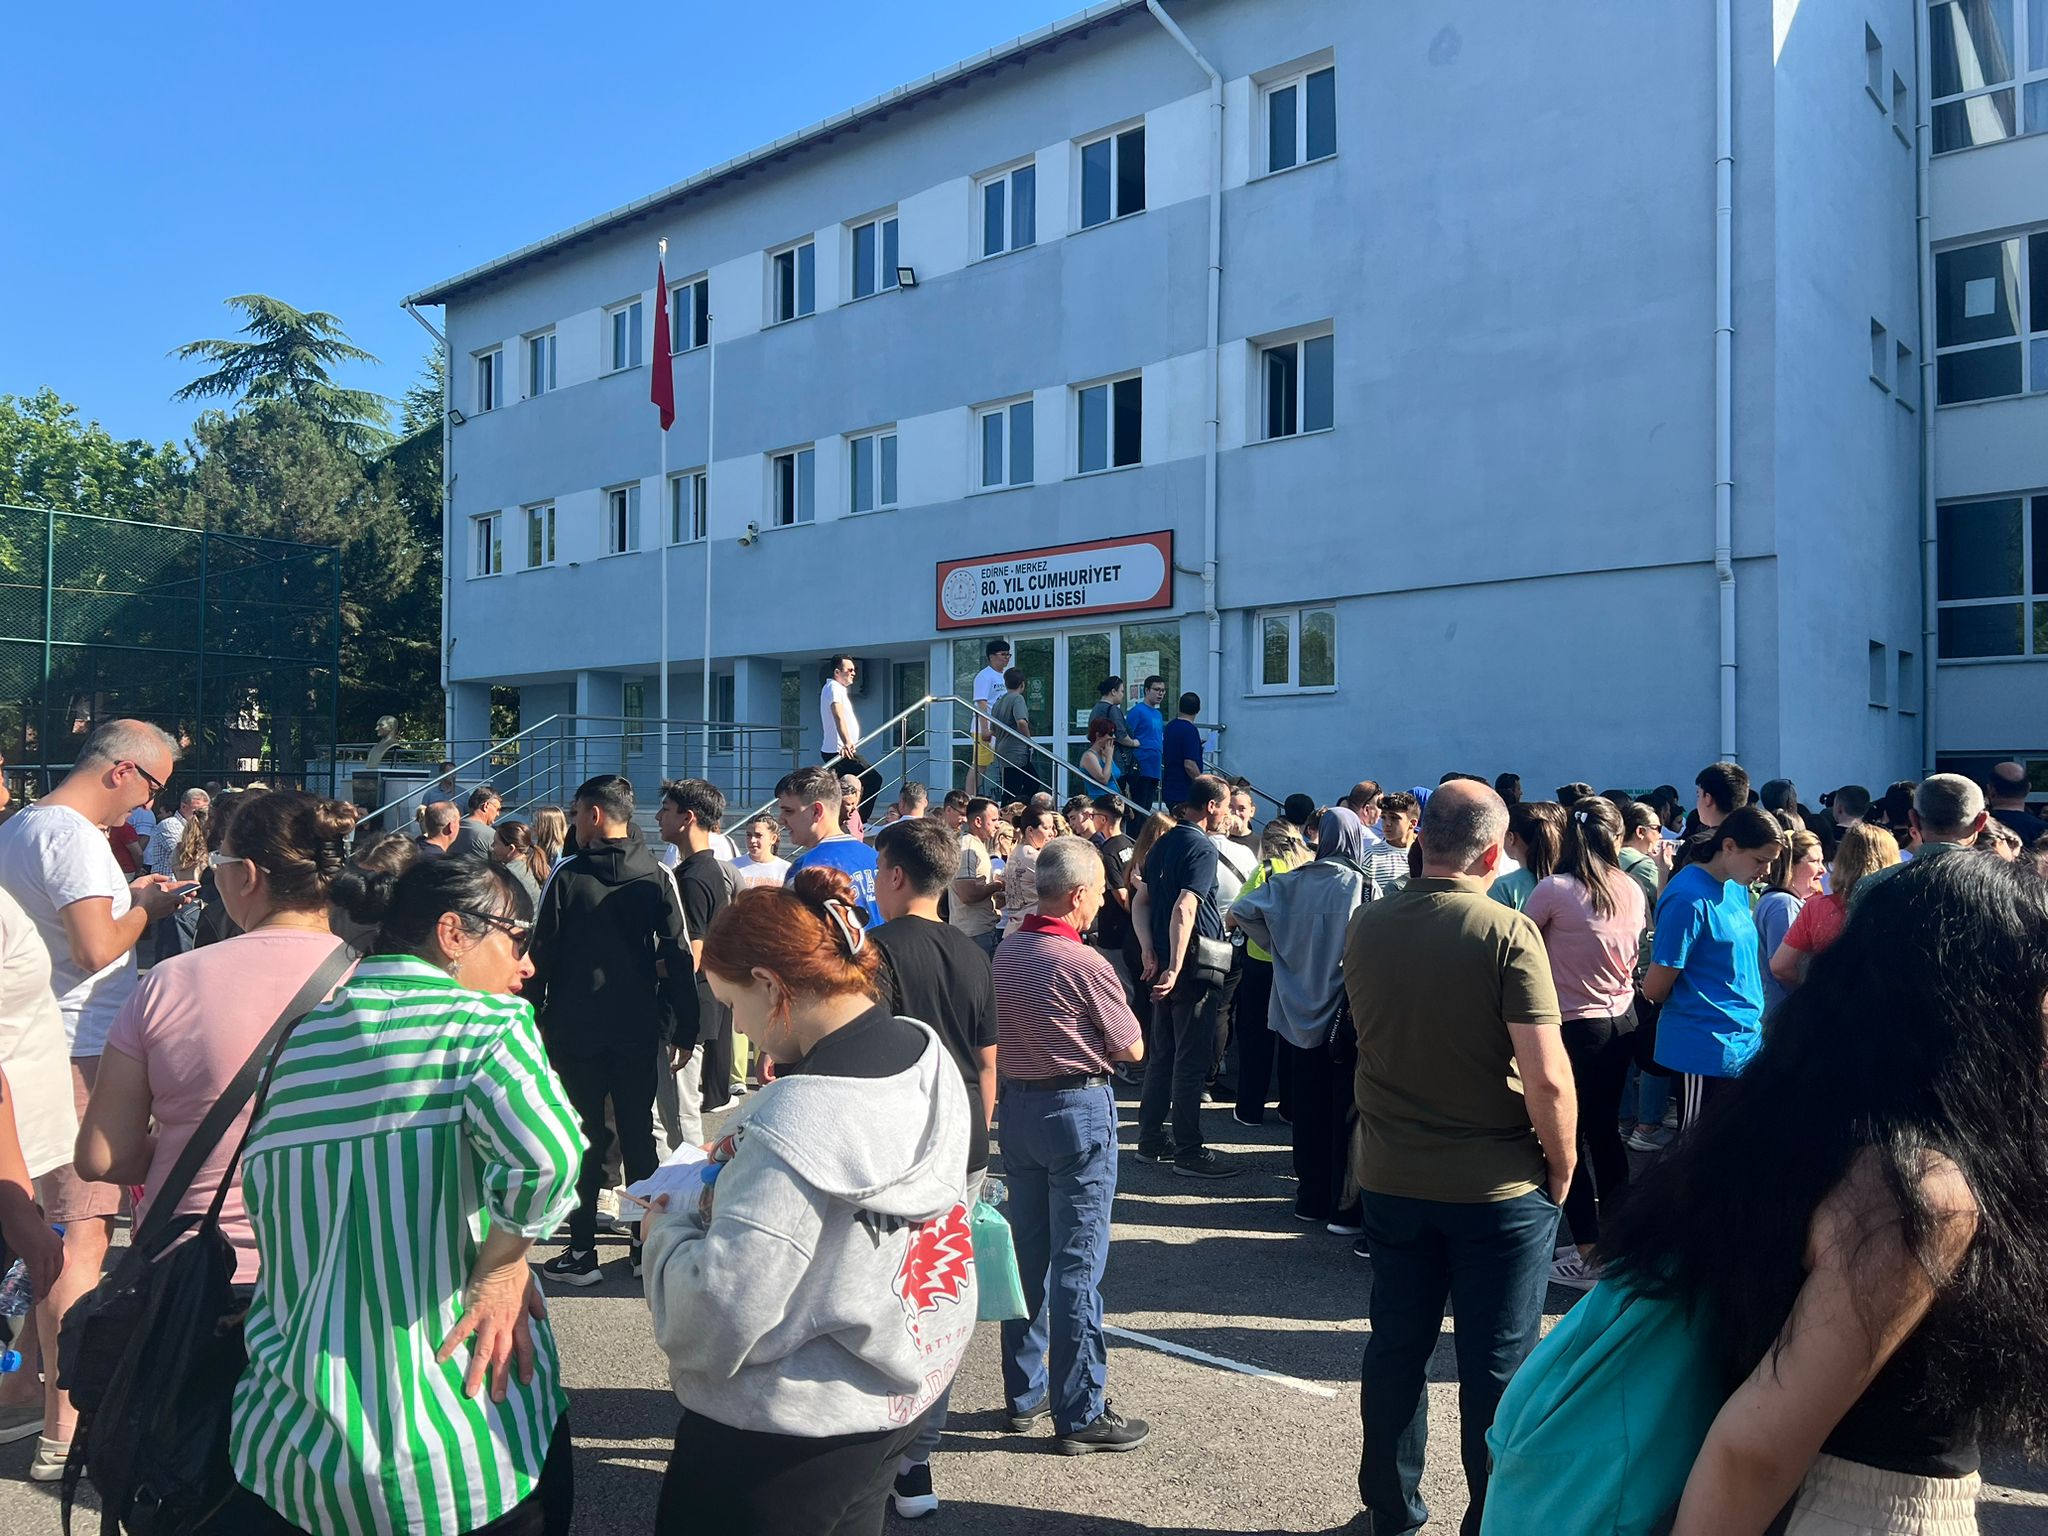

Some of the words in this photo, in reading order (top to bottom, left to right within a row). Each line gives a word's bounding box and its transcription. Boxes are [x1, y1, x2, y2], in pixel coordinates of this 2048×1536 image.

[981, 565, 1009, 579] EDİRNE
[1015, 561, 1048, 574] MERKEZ
[981, 580, 1000, 596] 80.
[1003, 577, 1025, 593] YIL
[1028, 565, 1121, 591] CUMHURİYET
[981, 595, 1040, 615] ANADOLU
[1044, 586, 1086, 608] LİSESİ
